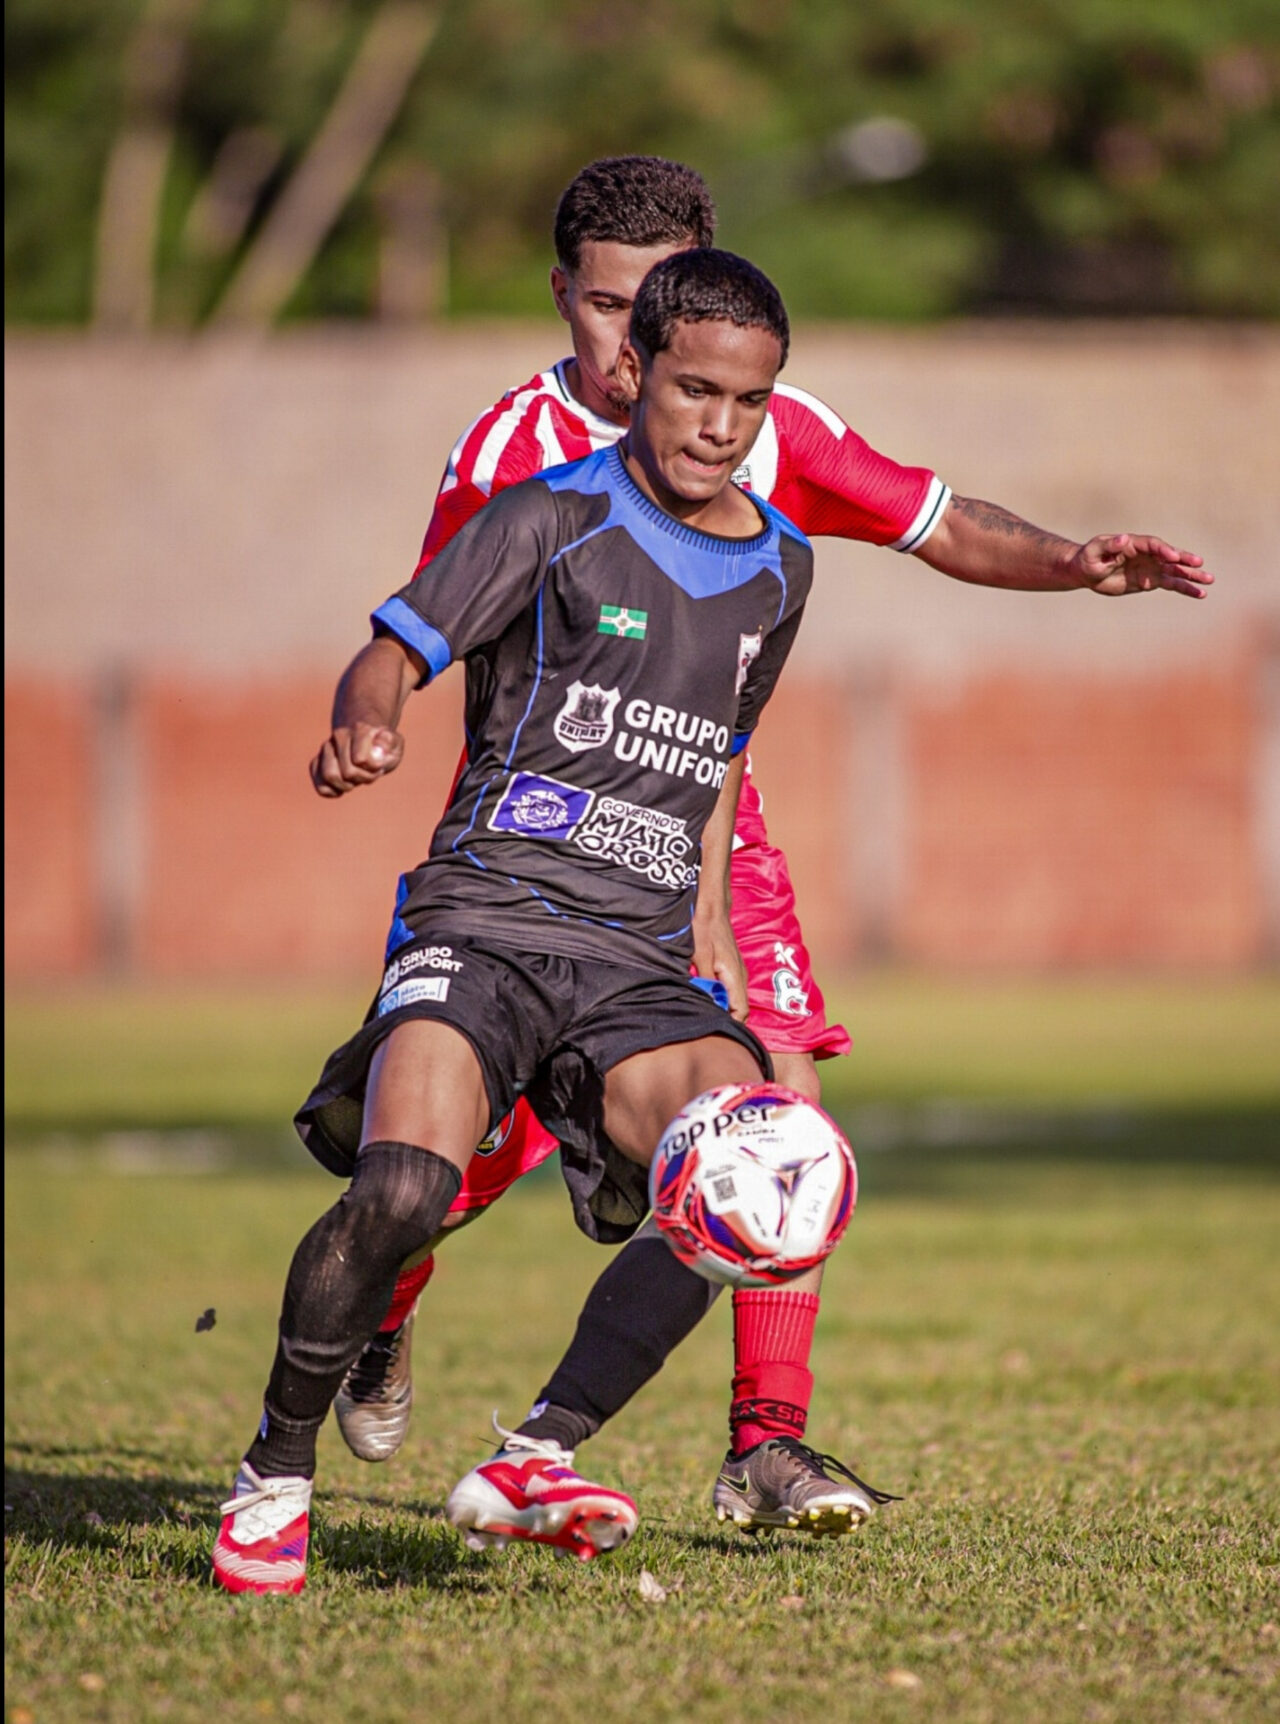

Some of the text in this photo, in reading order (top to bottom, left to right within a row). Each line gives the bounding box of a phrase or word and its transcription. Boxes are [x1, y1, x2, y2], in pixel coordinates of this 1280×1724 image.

[624, 699, 728, 754] GRUPO
[614, 731, 730, 789] UNIFOR
[587, 812, 692, 859] MATO
[601, 800, 670, 827] GOVERNO
[401, 946, 452, 966] GRUPO
